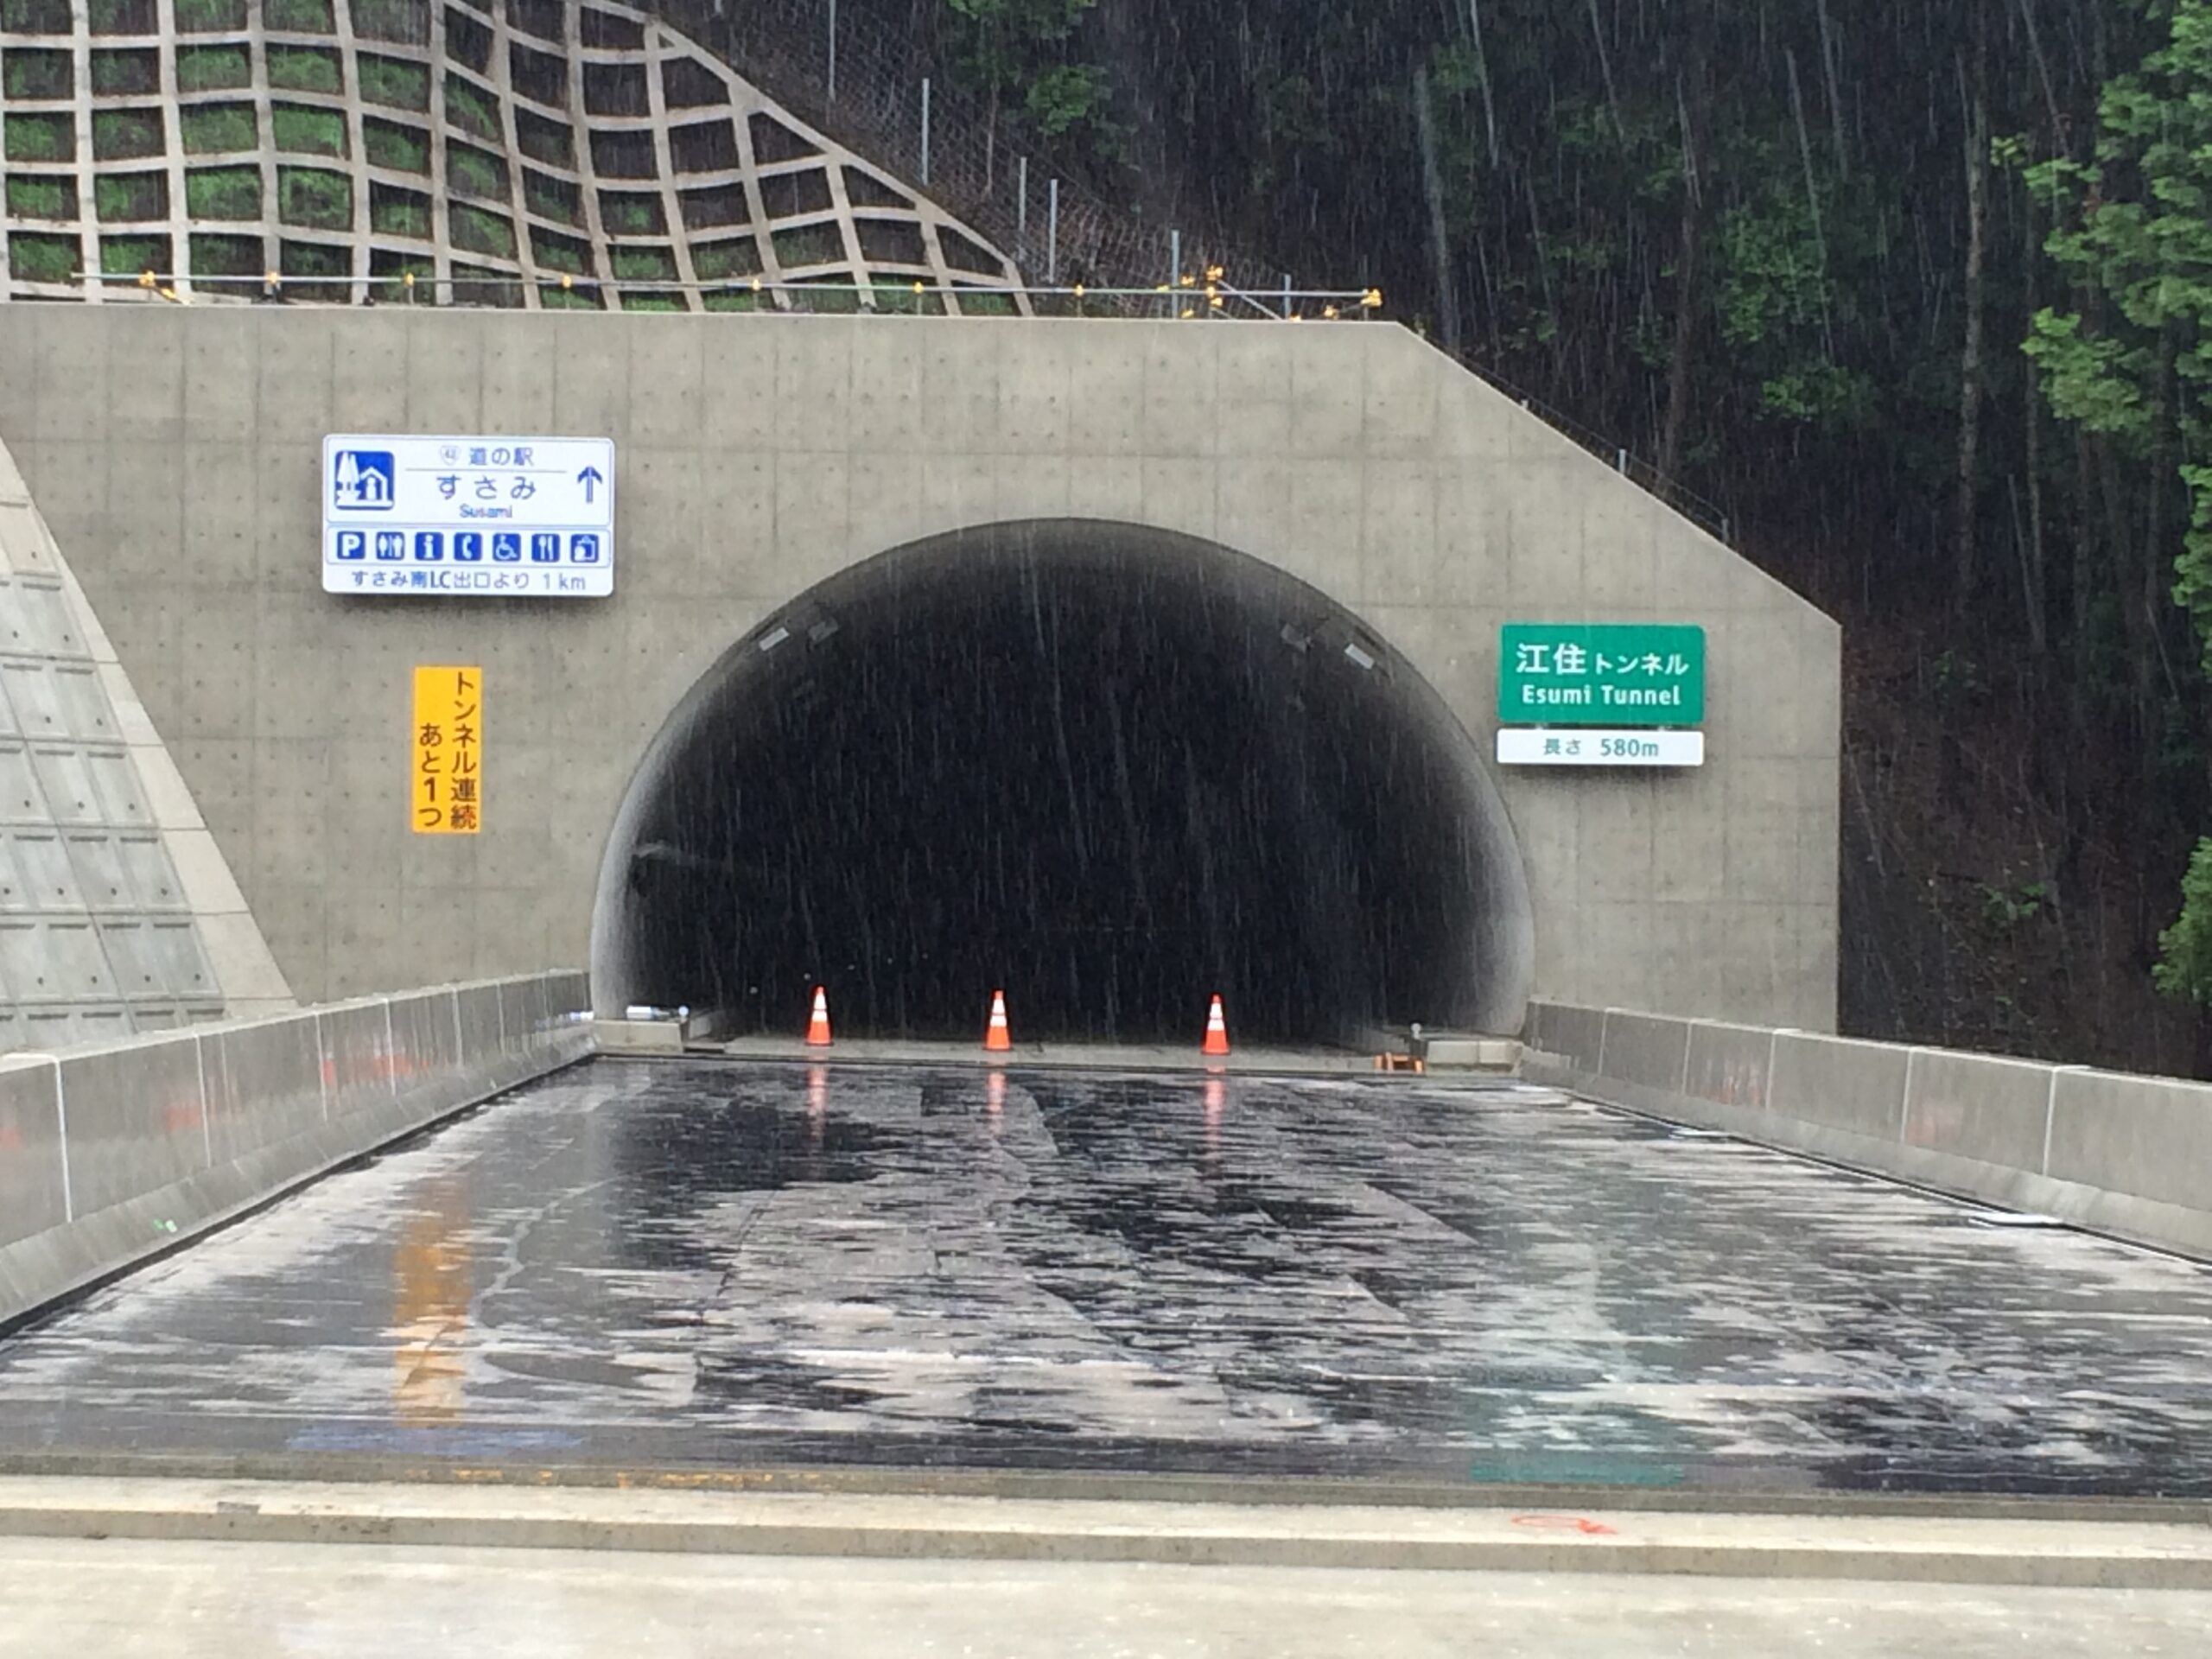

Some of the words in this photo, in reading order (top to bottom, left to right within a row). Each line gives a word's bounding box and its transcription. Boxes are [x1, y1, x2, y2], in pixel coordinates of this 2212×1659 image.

[469, 447, 534, 466] 道の駅
[436, 475, 536, 499] すさみ
[459, 504, 512, 518] Susami
[559, 573, 586, 589] km
[1516, 643, 1690, 677] 江住トンネル
[1522, 684, 1592, 704] Esumi
[1600, 684, 1681, 706] Tunnel
[450, 671, 477, 830] トンネル連続
[1543, 738, 1580, 756] 長さ
[1599, 739, 1659, 757] 580m
[419, 722, 442, 827] あと1つ
